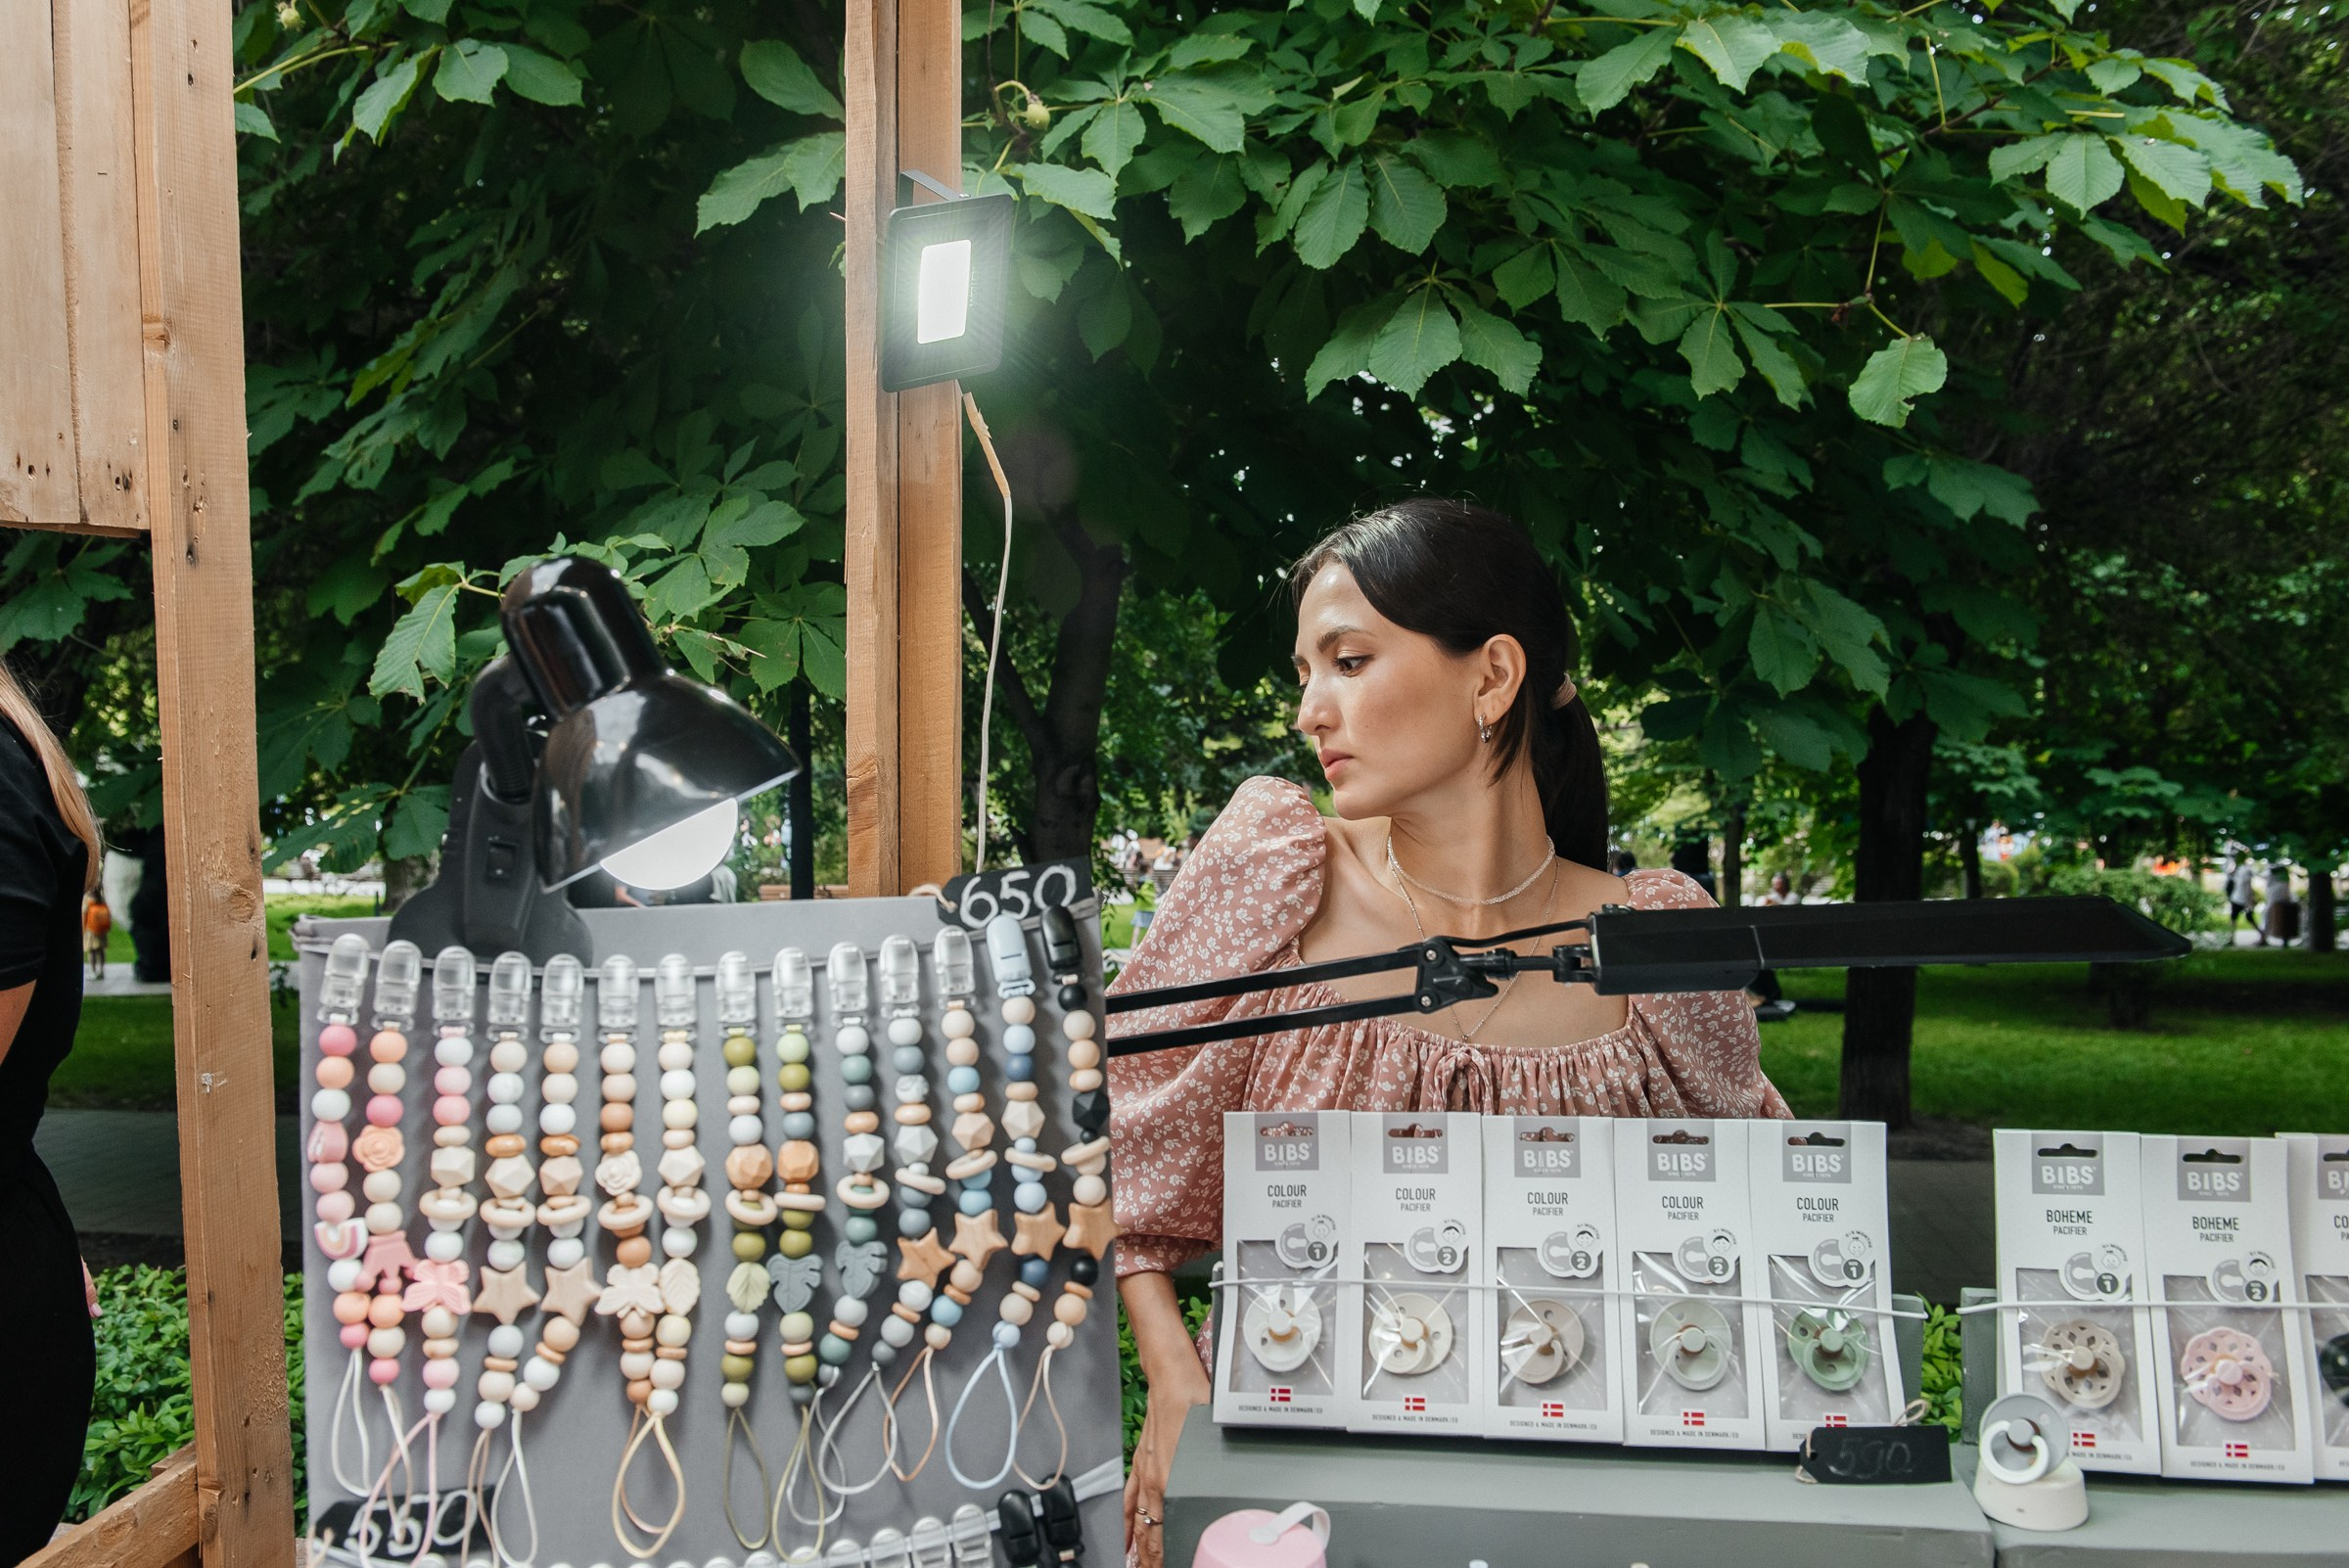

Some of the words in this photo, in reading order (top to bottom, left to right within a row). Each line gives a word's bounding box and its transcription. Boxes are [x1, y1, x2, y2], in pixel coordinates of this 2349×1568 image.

[959, 864, 1077, 929] 650
[1265, 1141, 1311, 1161] BIBS
[1392, 1145, 1440, 1164] BIBS
[1523, 1149, 1572, 1168] BIBS
[1657, 1152, 1707, 1172] BIBS
[1791, 1153, 1842, 1174] BIBS
[2041, 1165, 2095, 1185] BIBS
[2187, 1171, 2240, 1191] BIBS
[1267, 1184, 1307, 1197] COLOUR
[1396, 1187, 1436, 1201] COLOUR
[1527, 1191, 1568, 1205] COLOUR
[1662, 1195, 1704, 1209] COLOUR
[1796, 1197, 1839, 1211] COLOUR
[1400, 1203, 1431, 1212] PACIFIER
[1533, 1207, 1563, 1216] PACIFIER
[1668, 1212, 1699, 1221] PACIFIER
[1802, 1213, 1834, 1222] PACIFIER
[2046, 1209, 2094, 1223] BOHEME
[2052, 1225, 2087, 1235] PACIFIER
[2191, 1216, 2240, 1231] BOHEME
[2199, 1232, 2234, 1242] PACIFIER
[1313, 1248, 1320, 1260] 1
[1443, 1253, 1451, 1265] 2
[1577, 1258, 1586, 1268] 2
[1714, 1263, 1724, 1274] 2
[1850, 1267, 1857, 1278] 1
[2103, 1280, 2112, 1292] 1
[2251, 1287, 2262, 1300] 2
[344, 1489, 478, 1557] 550
